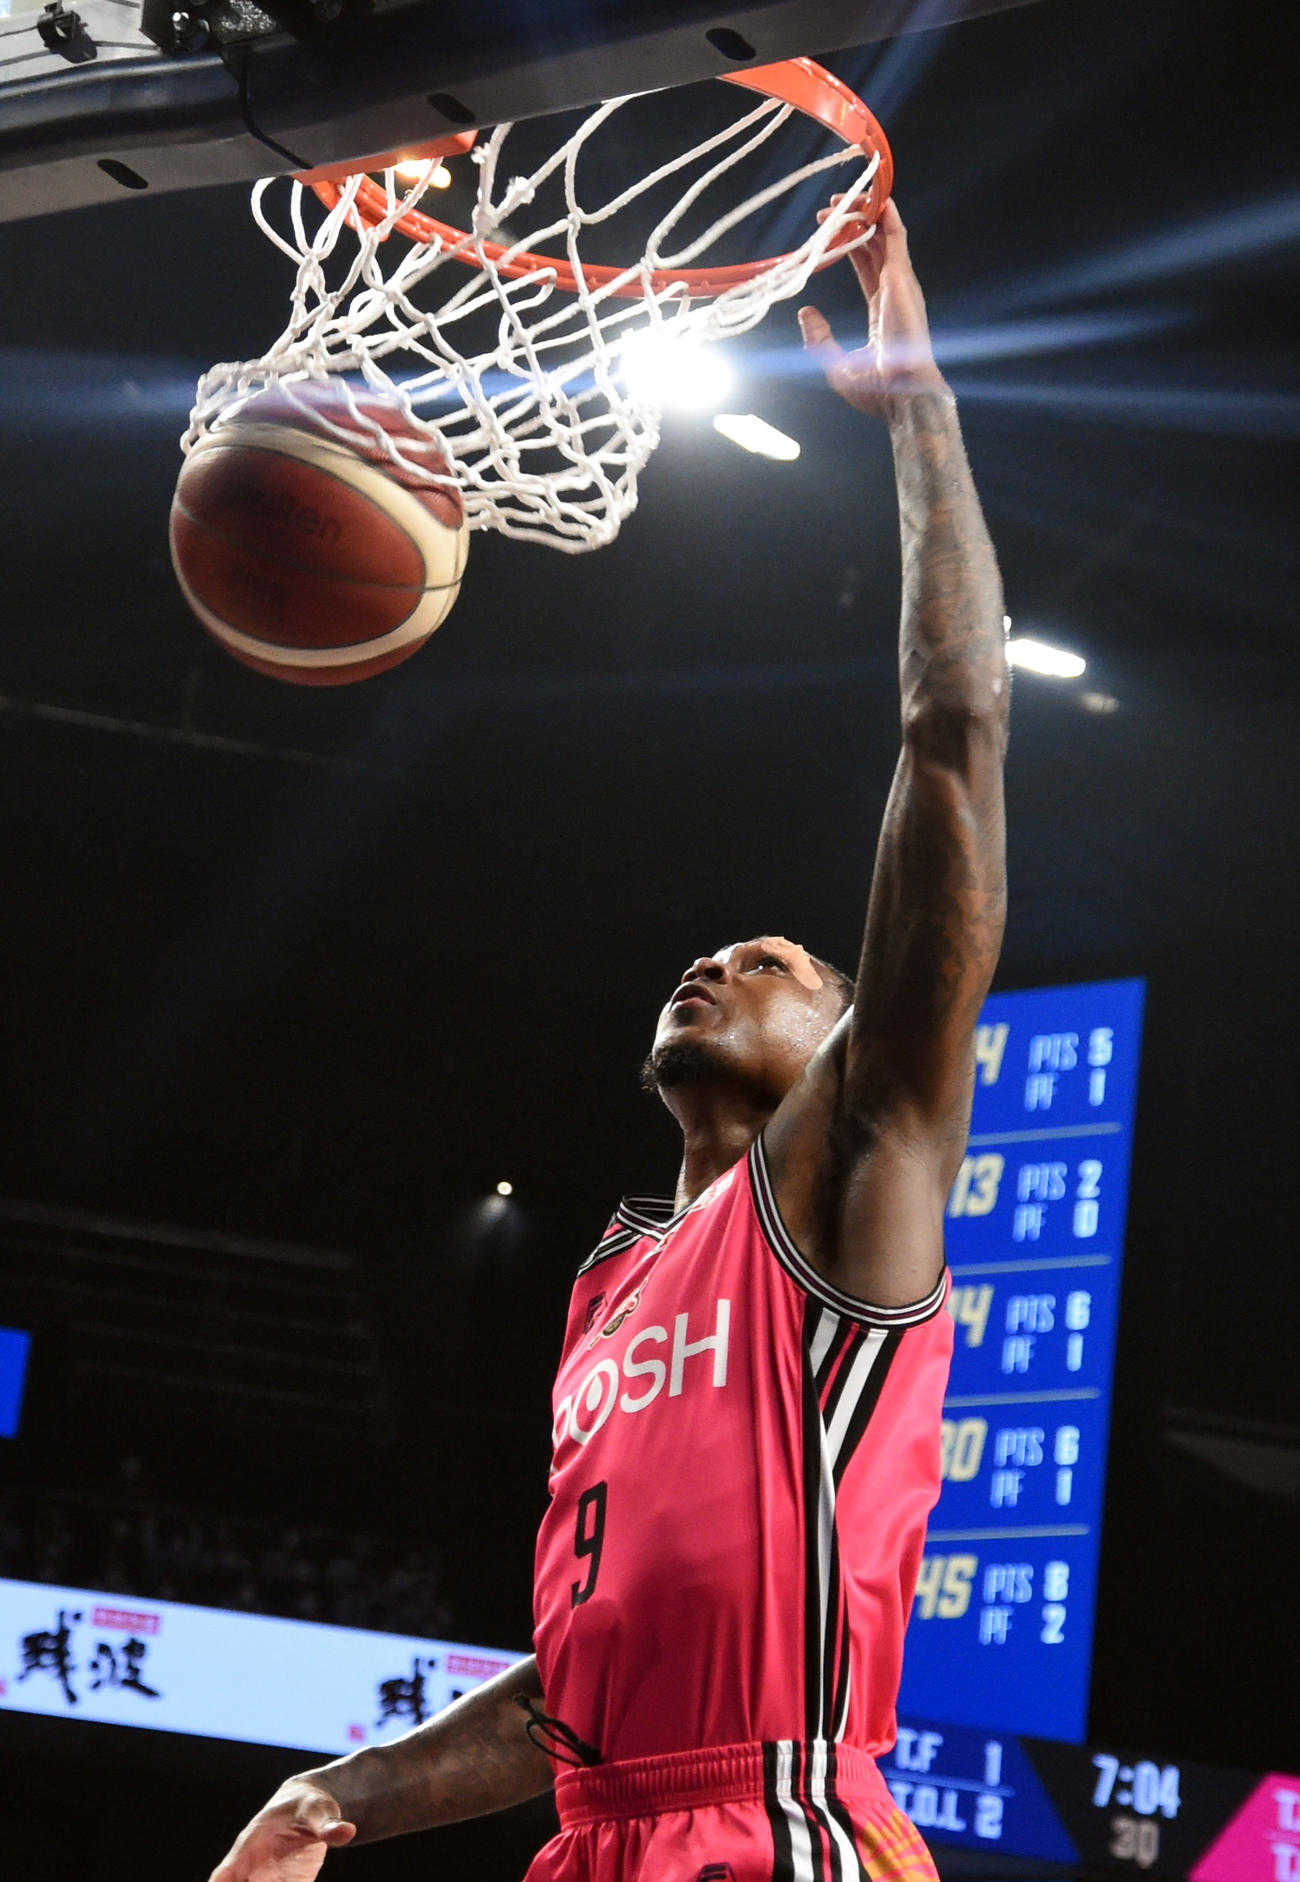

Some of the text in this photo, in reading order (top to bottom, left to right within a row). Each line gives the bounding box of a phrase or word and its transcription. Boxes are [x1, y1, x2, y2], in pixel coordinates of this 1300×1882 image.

[1089, 1067, 1106, 1107] 1
[950, 1152, 1005, 1218] 13
[1077, 1160, 1103, 1199] 2
[1073, 1199, 1099, 1238] 0
[1067, 1332, 1083, 1372] 1
[1055, 1467, 1072, 1506] 1
[571, 1480, 608, 1610] 9
[915, 1552, 979, 1620] 45
[1040, 1603, 1066, 1644] 2
[984, 1740, 1002, 1786] 1
[1091, 1753, 1181, 1819] 7:04
